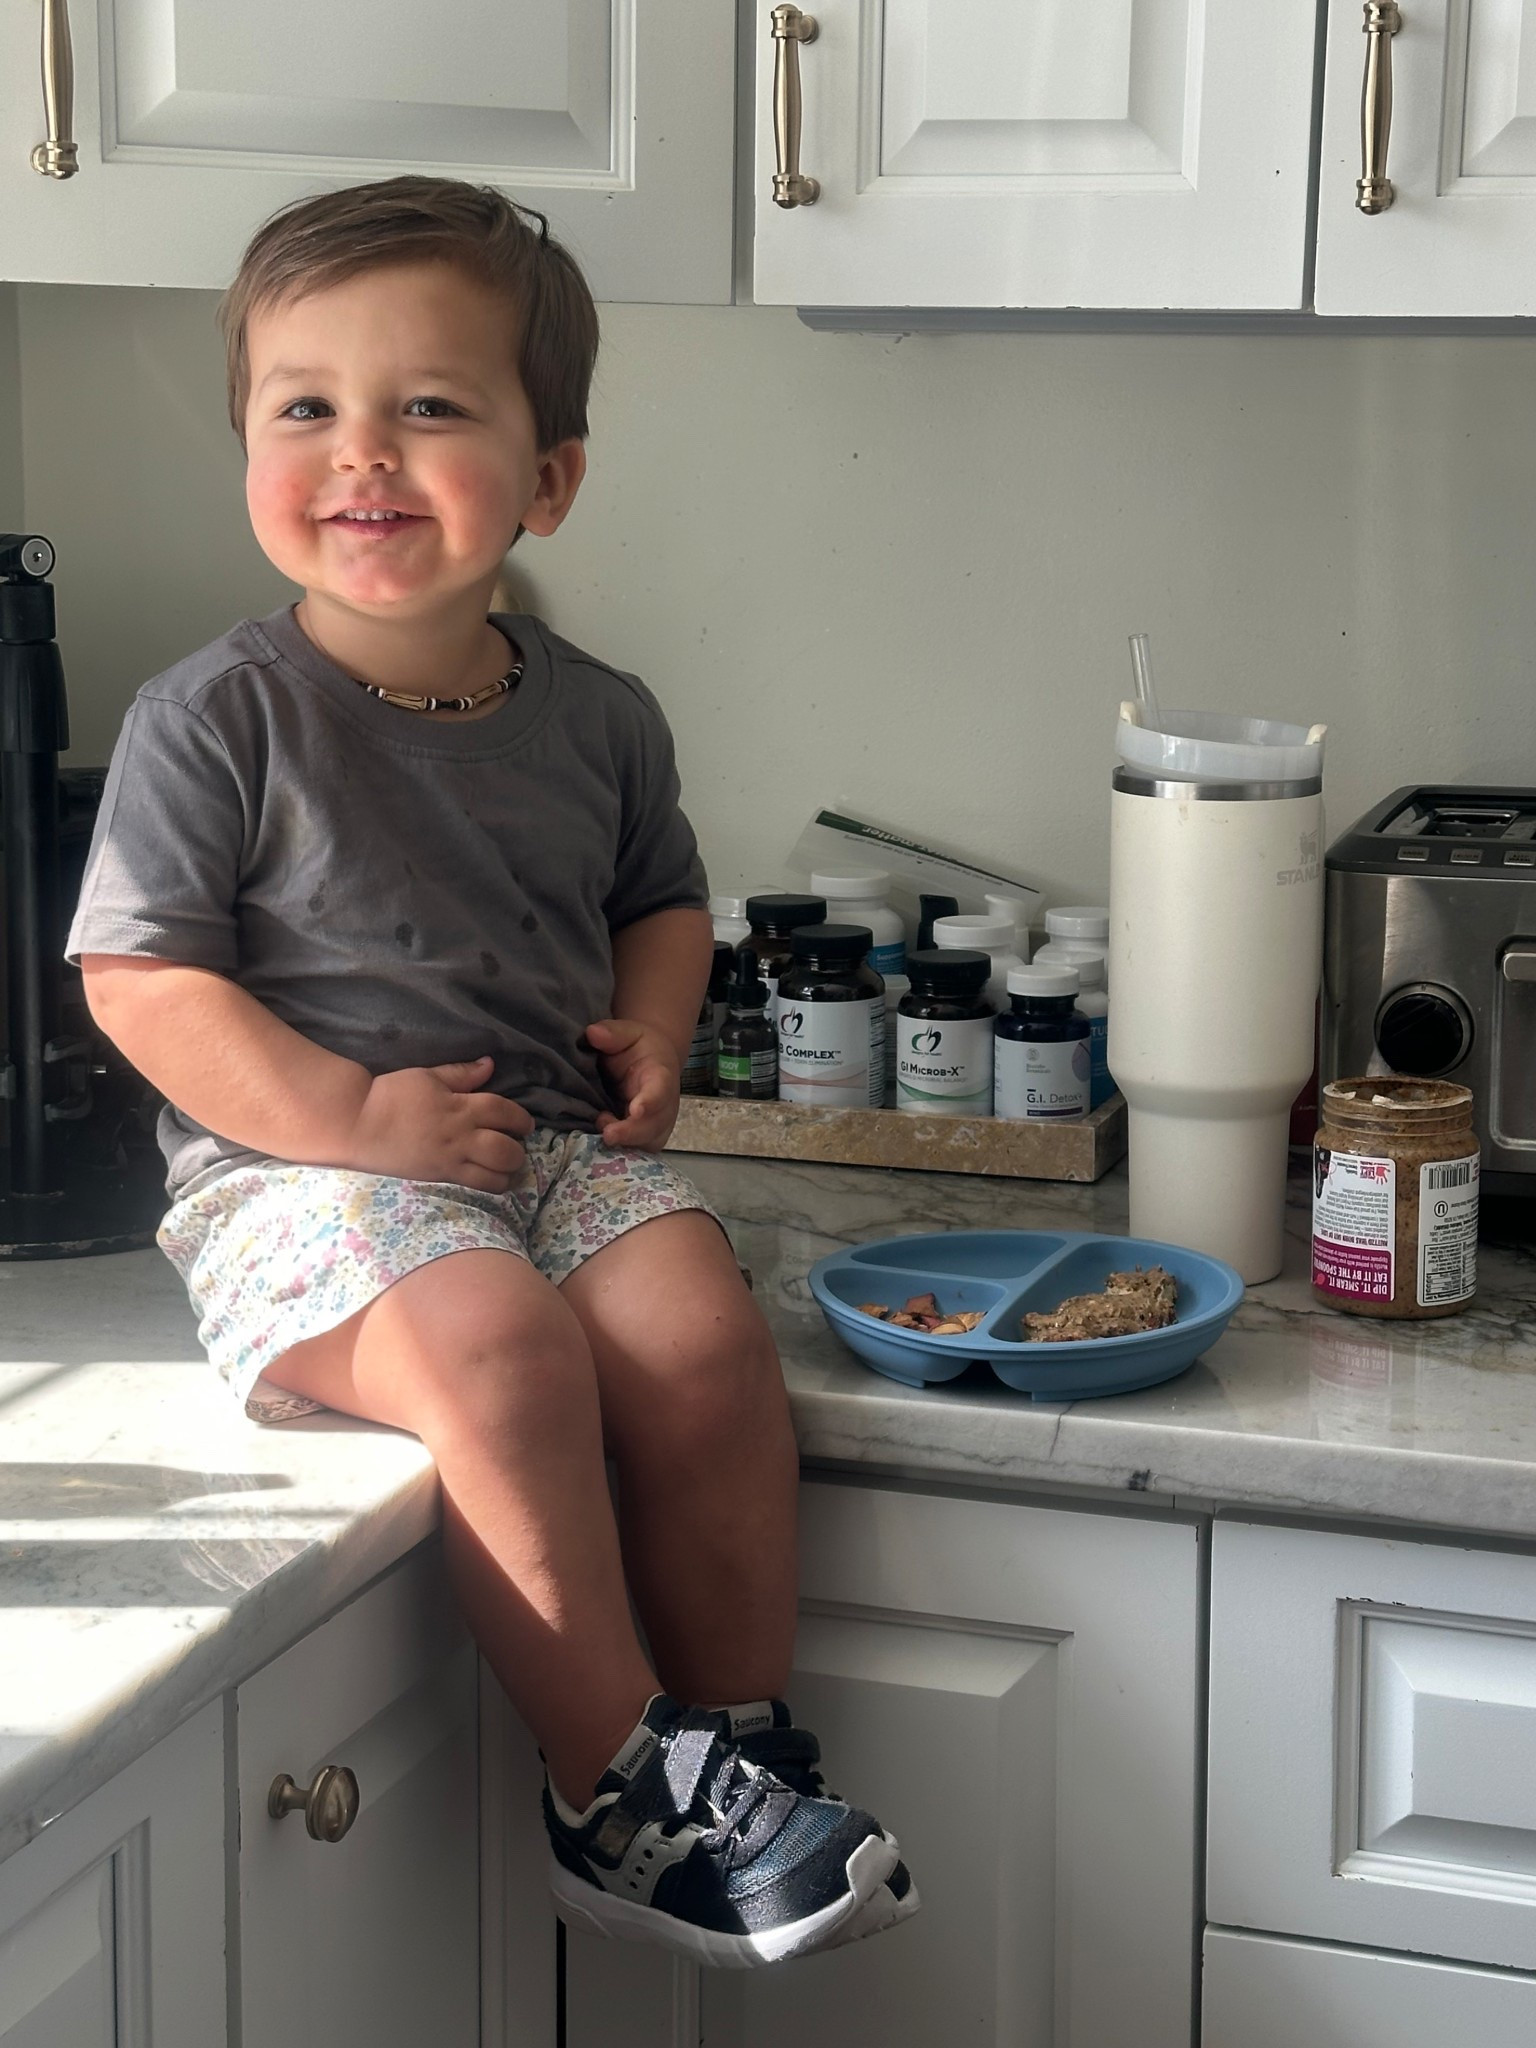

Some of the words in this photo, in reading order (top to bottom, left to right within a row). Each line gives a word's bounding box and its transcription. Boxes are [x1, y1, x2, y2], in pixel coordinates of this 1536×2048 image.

[1339, 1267, 1351, 1278] THE
[1352, 1270, 1362, 1280] BY
[1364, 1271, 1371, 1281] IT
[1374, 1272, 1388, 1283] EAT
[1336, 1278, 1359, 1291] SMEAR
[1373, 1284, 1387, 1294] DIP
[734, 1714, 770, 1731] Saucony
[620, 1734, 655, 1776] Saucony
